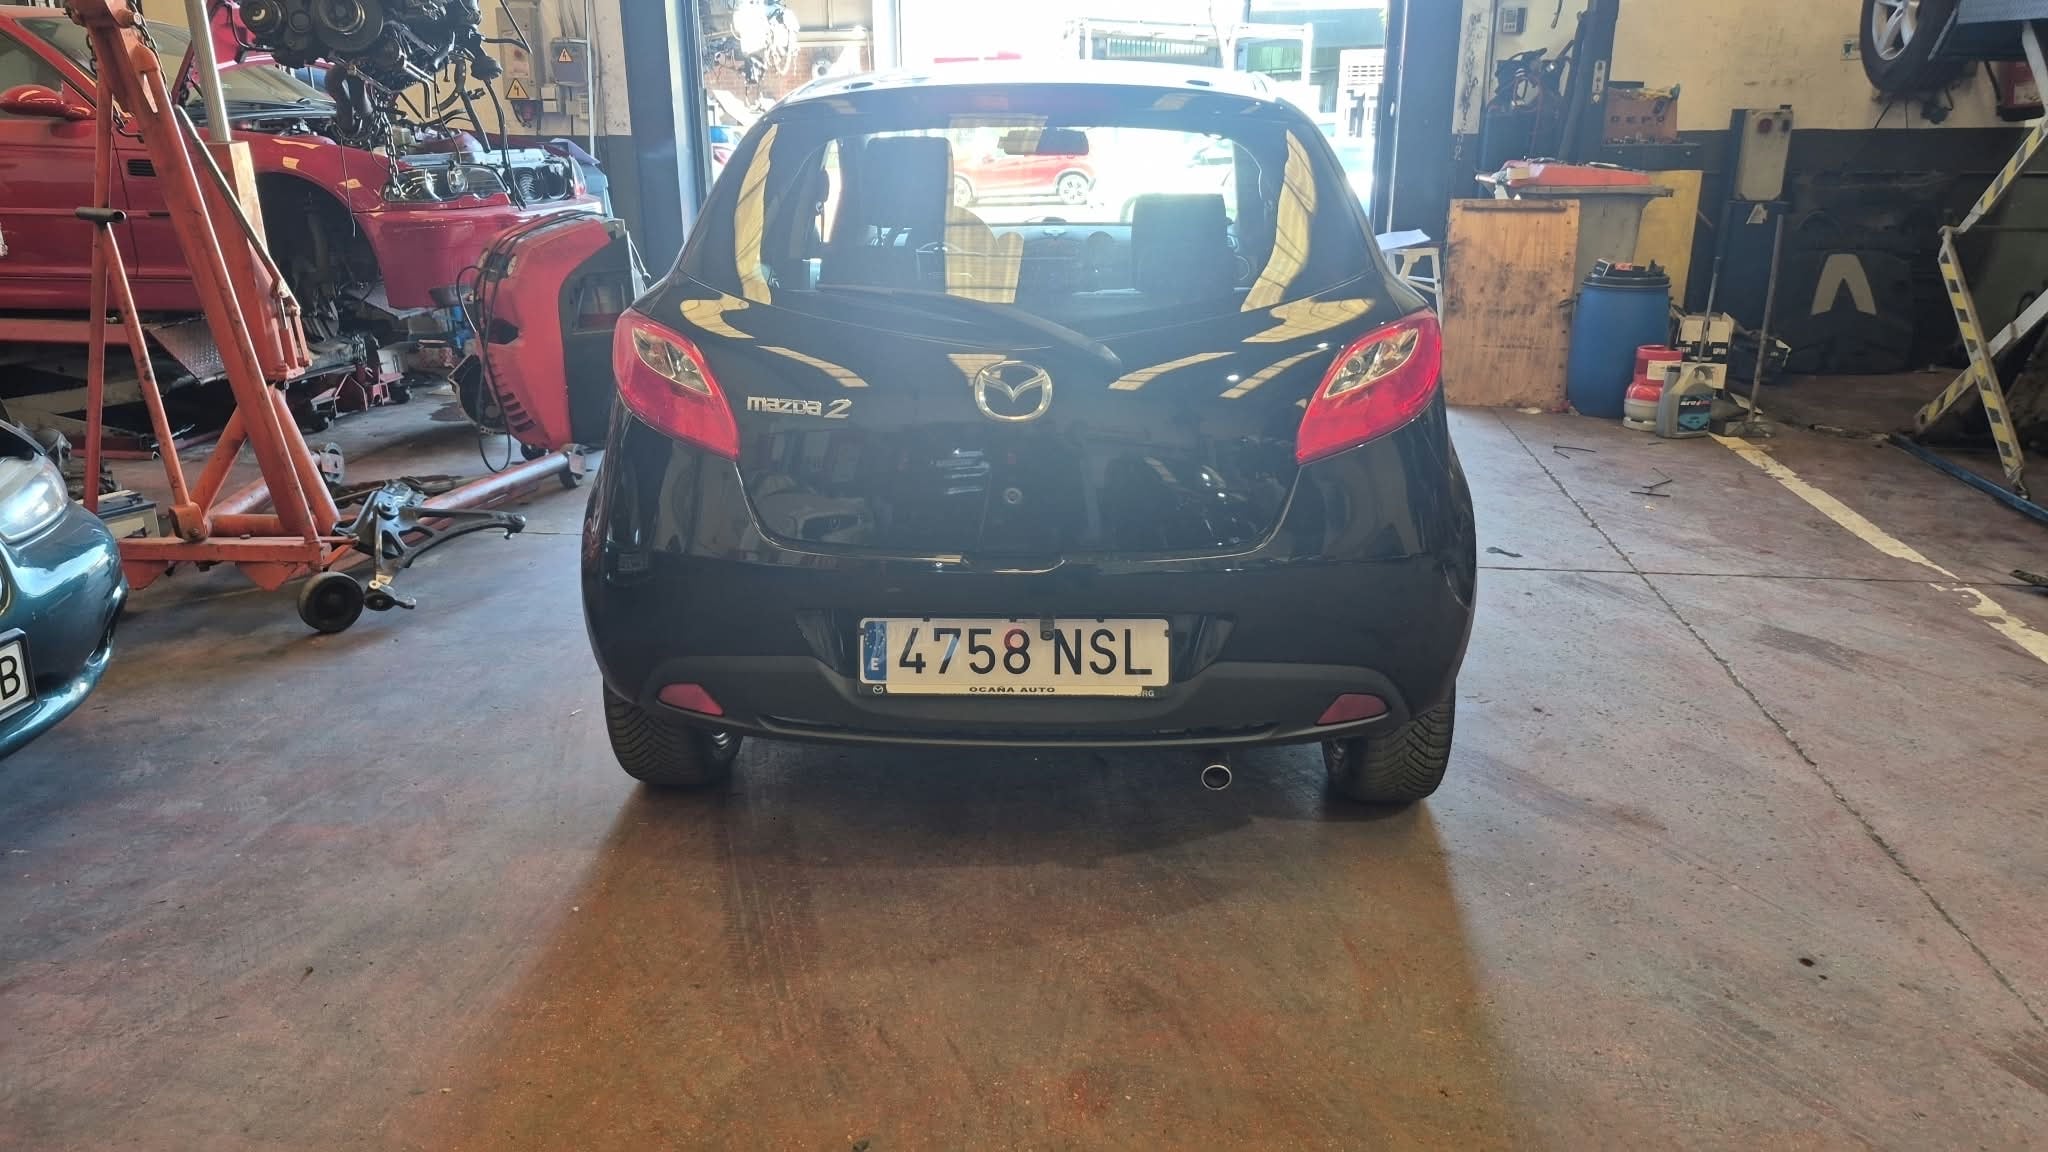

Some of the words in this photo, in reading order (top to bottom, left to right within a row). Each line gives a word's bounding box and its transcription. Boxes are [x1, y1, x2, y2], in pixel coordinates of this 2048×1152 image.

[824, 398, 853, 419] 2
[899, 627, 1031, 675] 4758
[1053, 628, 1153, 676] NSL
[870, 657, 880, 671] E
[0, 655, 21, 700] B
[968, 685, 1015, 693] OCAÑA
